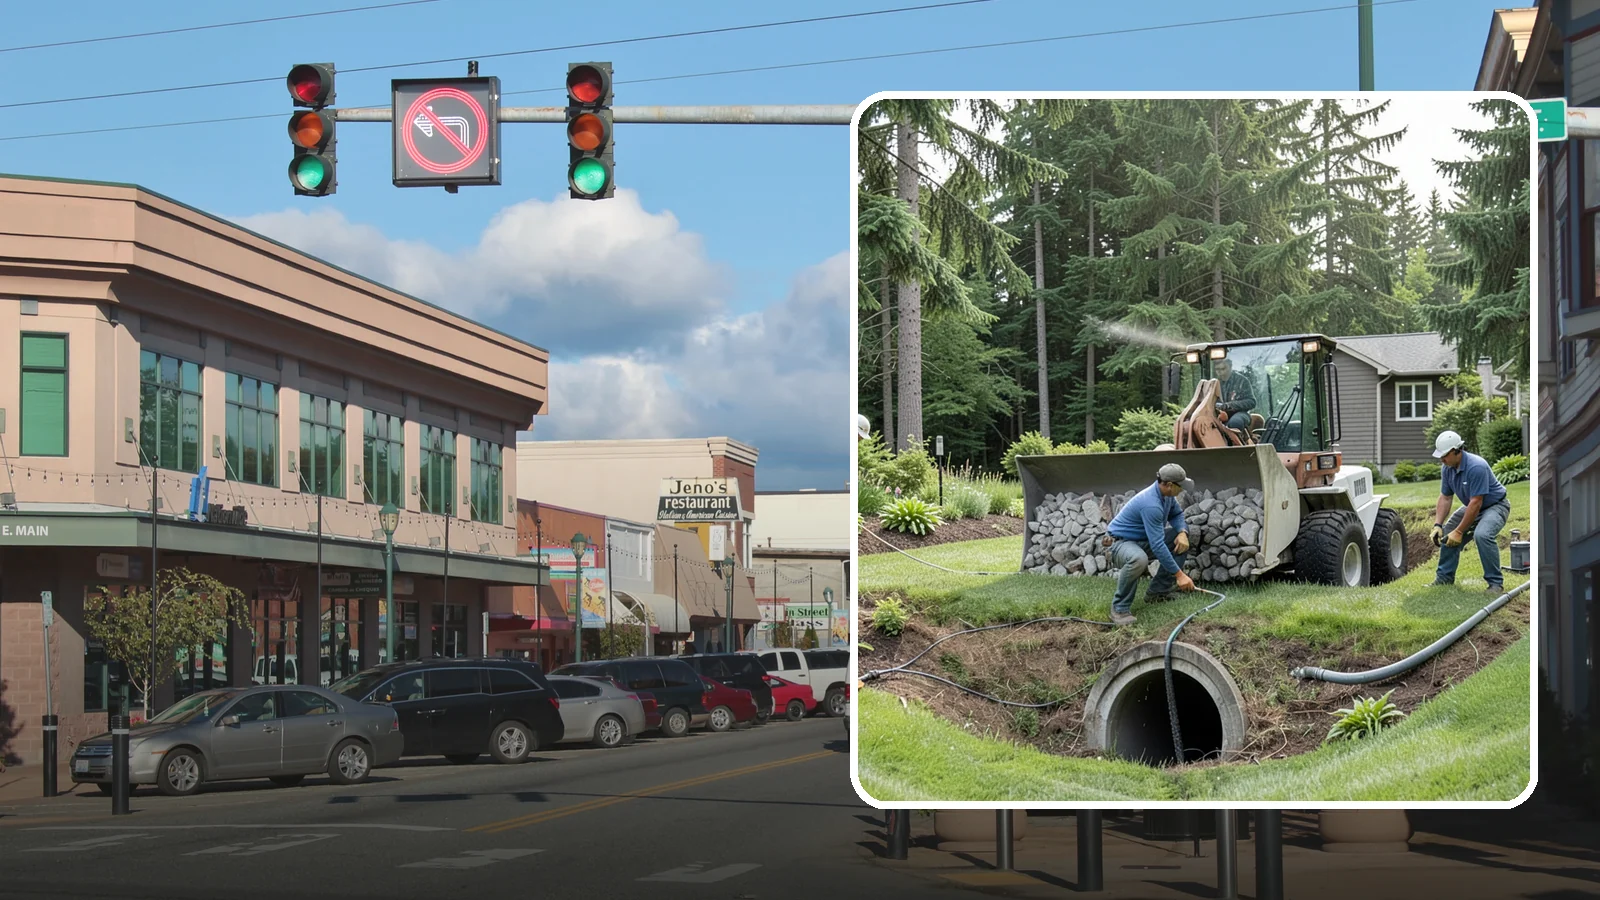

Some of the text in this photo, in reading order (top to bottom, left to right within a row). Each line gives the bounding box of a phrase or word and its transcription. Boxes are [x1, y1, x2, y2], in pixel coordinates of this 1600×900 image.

[669, 479, 727, 494] Jeno's
[665, 496, 731, 509] restaurant
[659, 510, 681, 519] Italian
[686, 510, 714, 519] American
[715, 509, 737, 519] Cuisine
[2, 525, 49, 536] E. MAIN
[797, 608, 828, 616] Street
